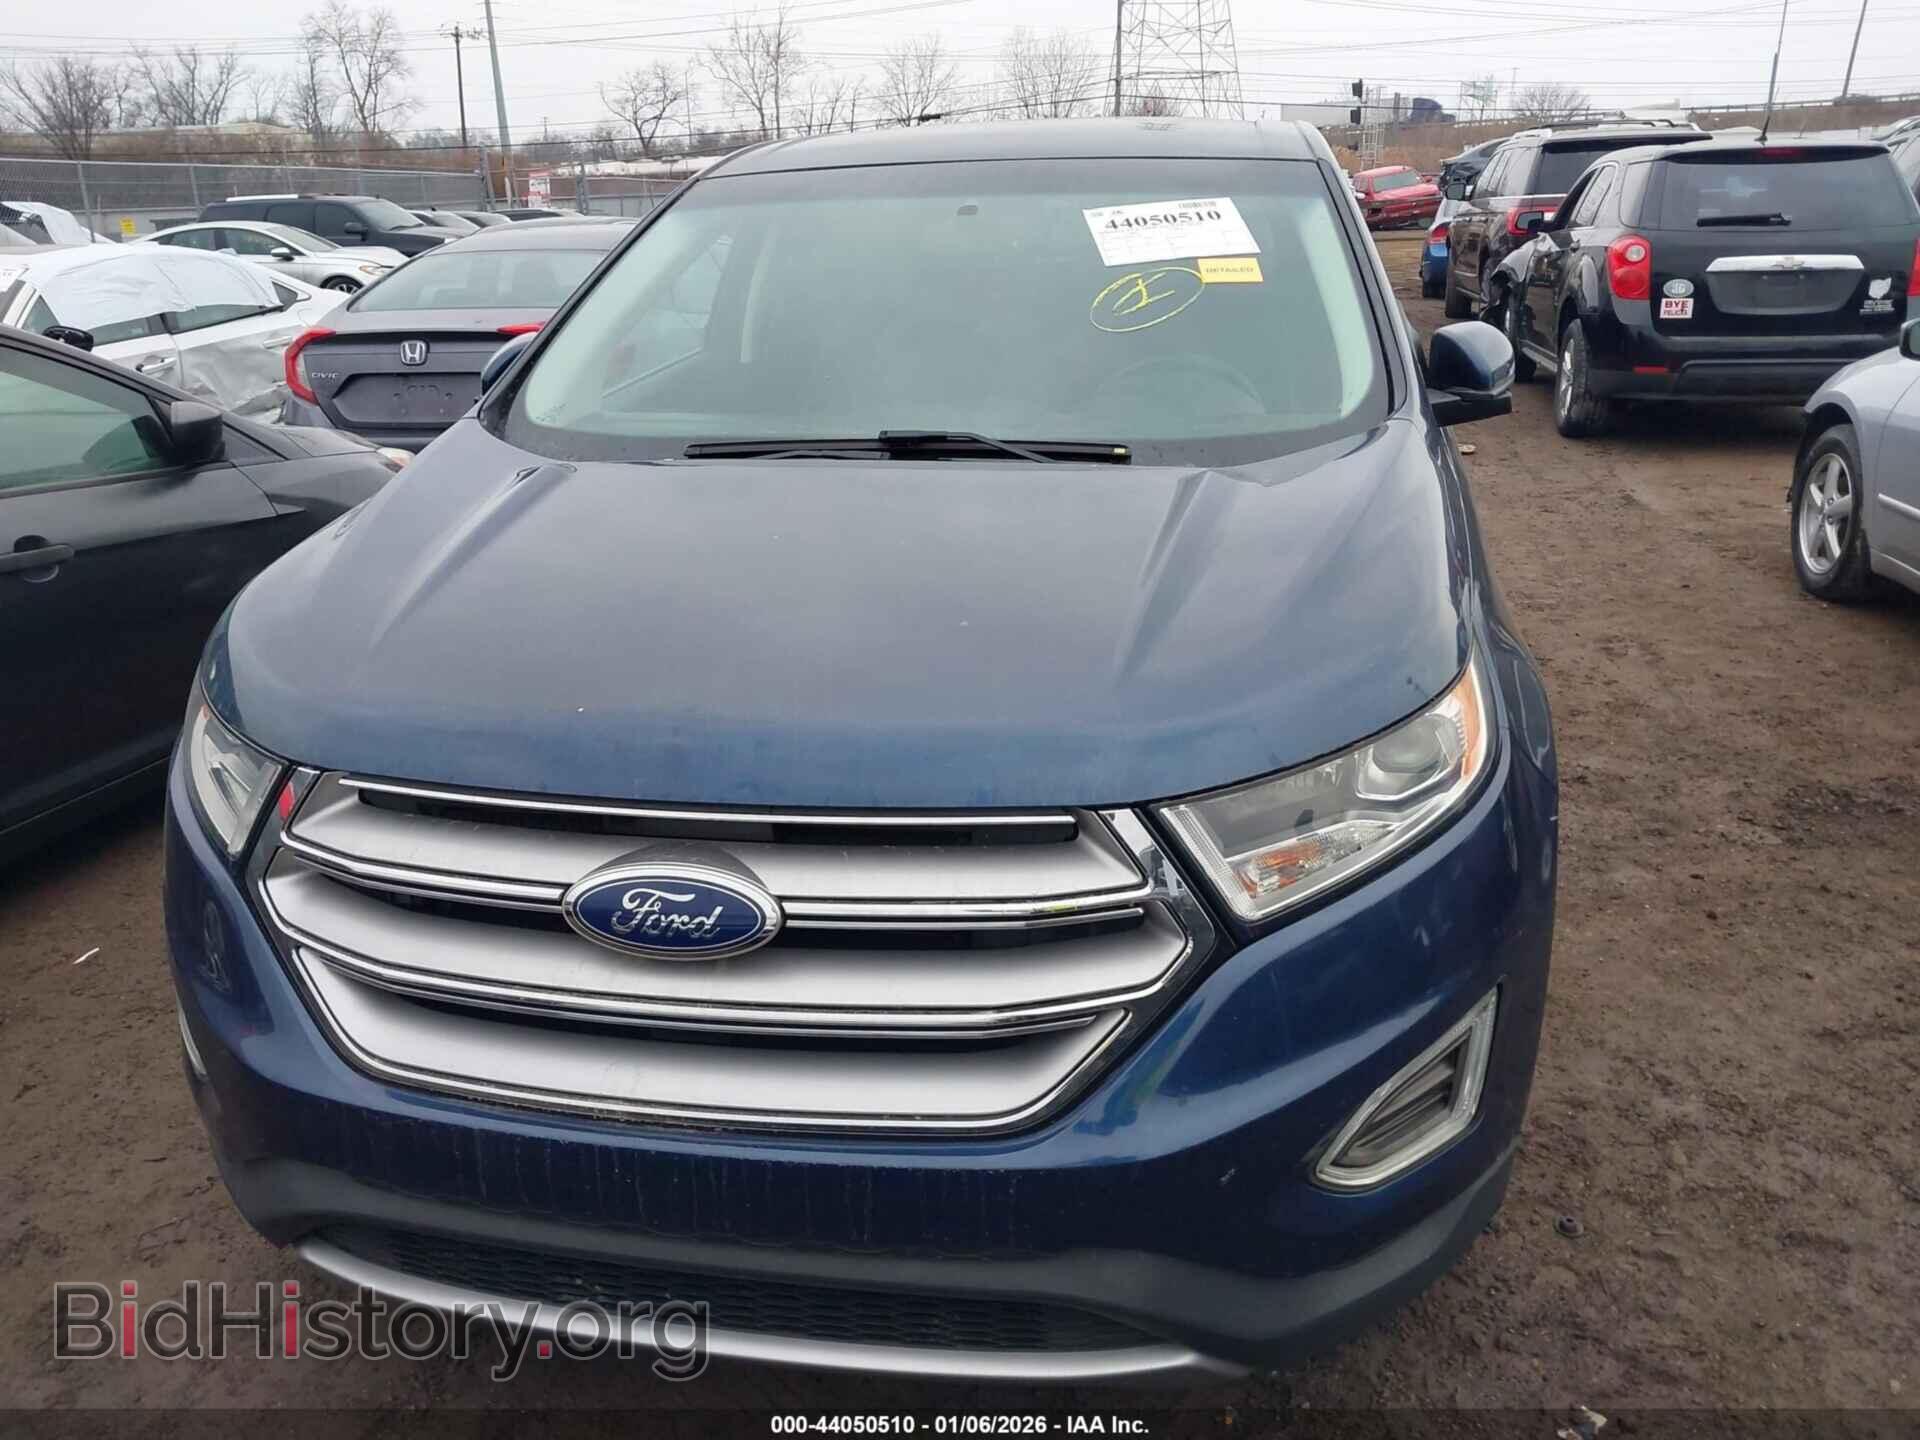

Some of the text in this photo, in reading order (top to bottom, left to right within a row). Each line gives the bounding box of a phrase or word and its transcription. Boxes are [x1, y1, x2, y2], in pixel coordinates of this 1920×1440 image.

[1104, 208, 1222, 230] 44050510
[1664, 300, 1689, 309] BYE
[610, 887, 724, 939] Ford
